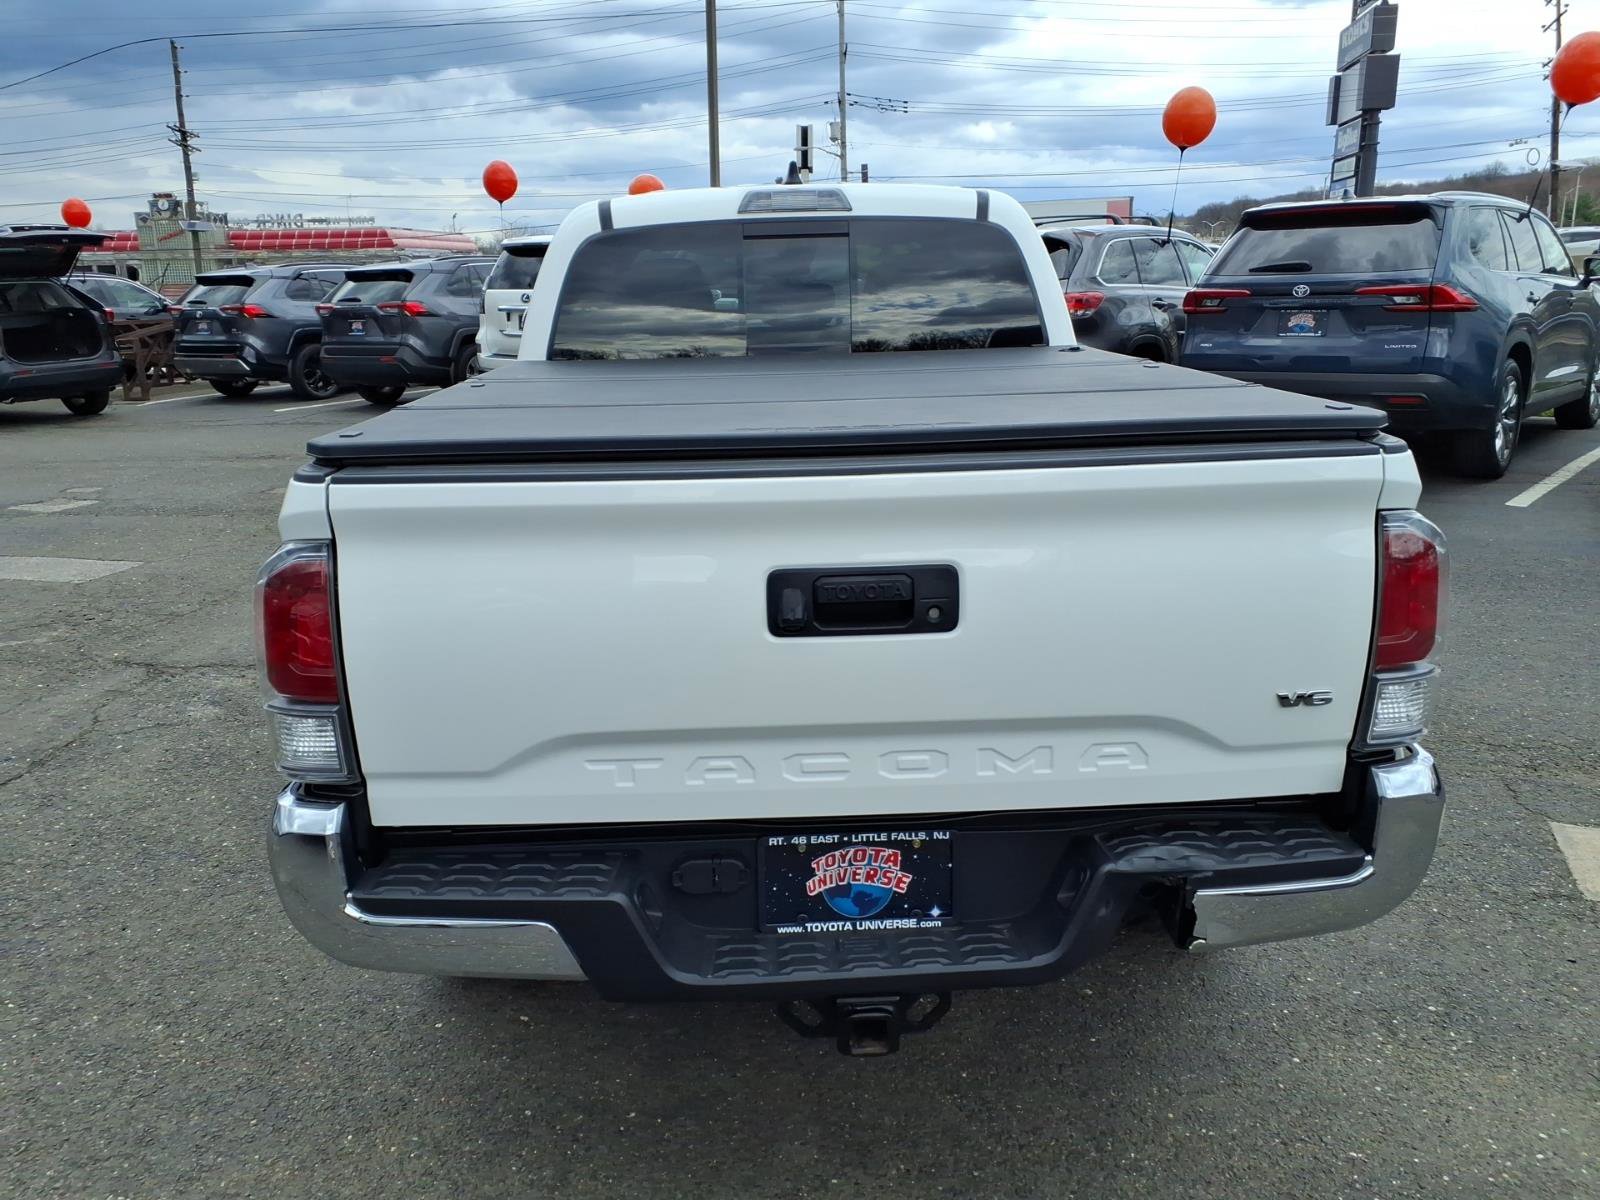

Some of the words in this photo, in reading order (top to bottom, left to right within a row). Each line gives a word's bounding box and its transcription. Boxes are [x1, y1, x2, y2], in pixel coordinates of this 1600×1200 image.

[822, 582, 908, 601] TOYOTA
[1276, 689, 1333, 708] V6
[583, 741, 1150, 788] TACOMA
[791, 836, 807, 845] 46
[810, 834, 840, 844] EAST
[852, 833, 888, 843] LITTLE
[933, 831, 950, 840] NJ
[813, 847, 901, 873] TOYOTA
[806, 866, 912, 896] UNIVERSE
